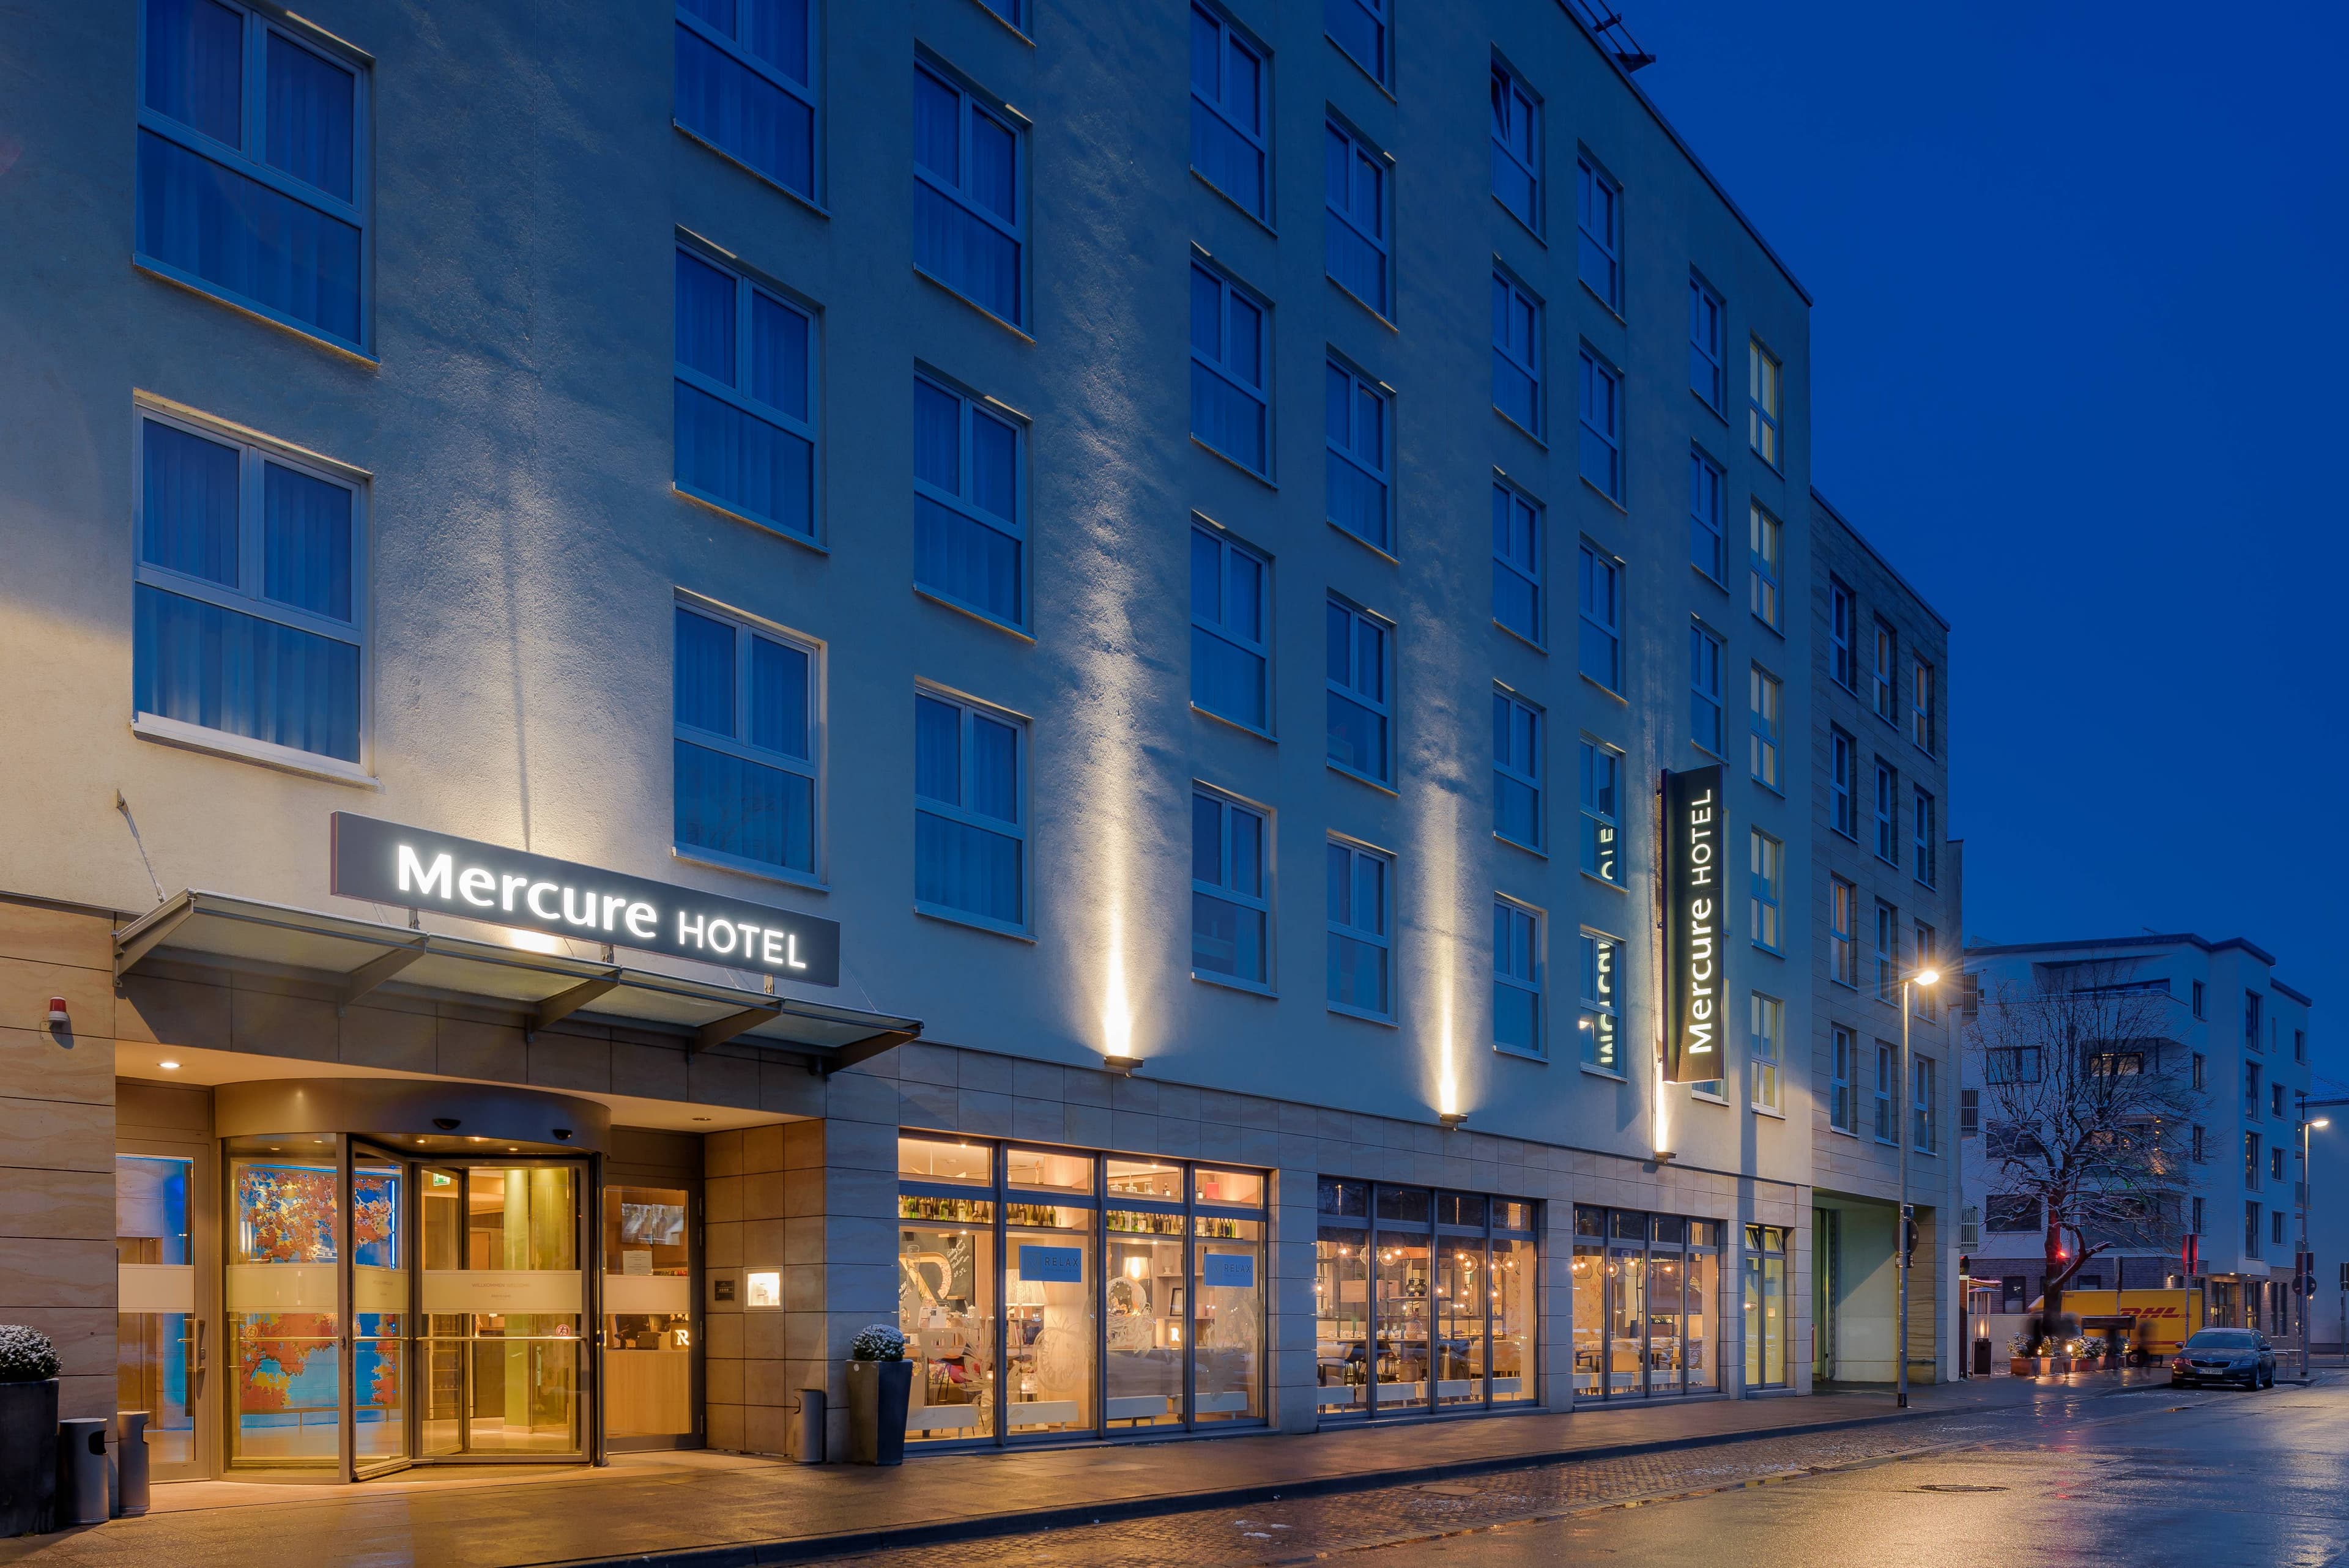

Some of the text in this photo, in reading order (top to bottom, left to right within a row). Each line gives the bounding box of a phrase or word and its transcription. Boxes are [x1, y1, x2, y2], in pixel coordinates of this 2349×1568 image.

[398, 845, 806, 969] Mercure HOTEL
[1688, 789, 1712, 1054] Mercure HOTEL
[1045, 1257, 1078, 1267] RELAX
[1224, 1263, 1251, 1273] RELAX
[2120, 1307, 2179, 1318] DHL
